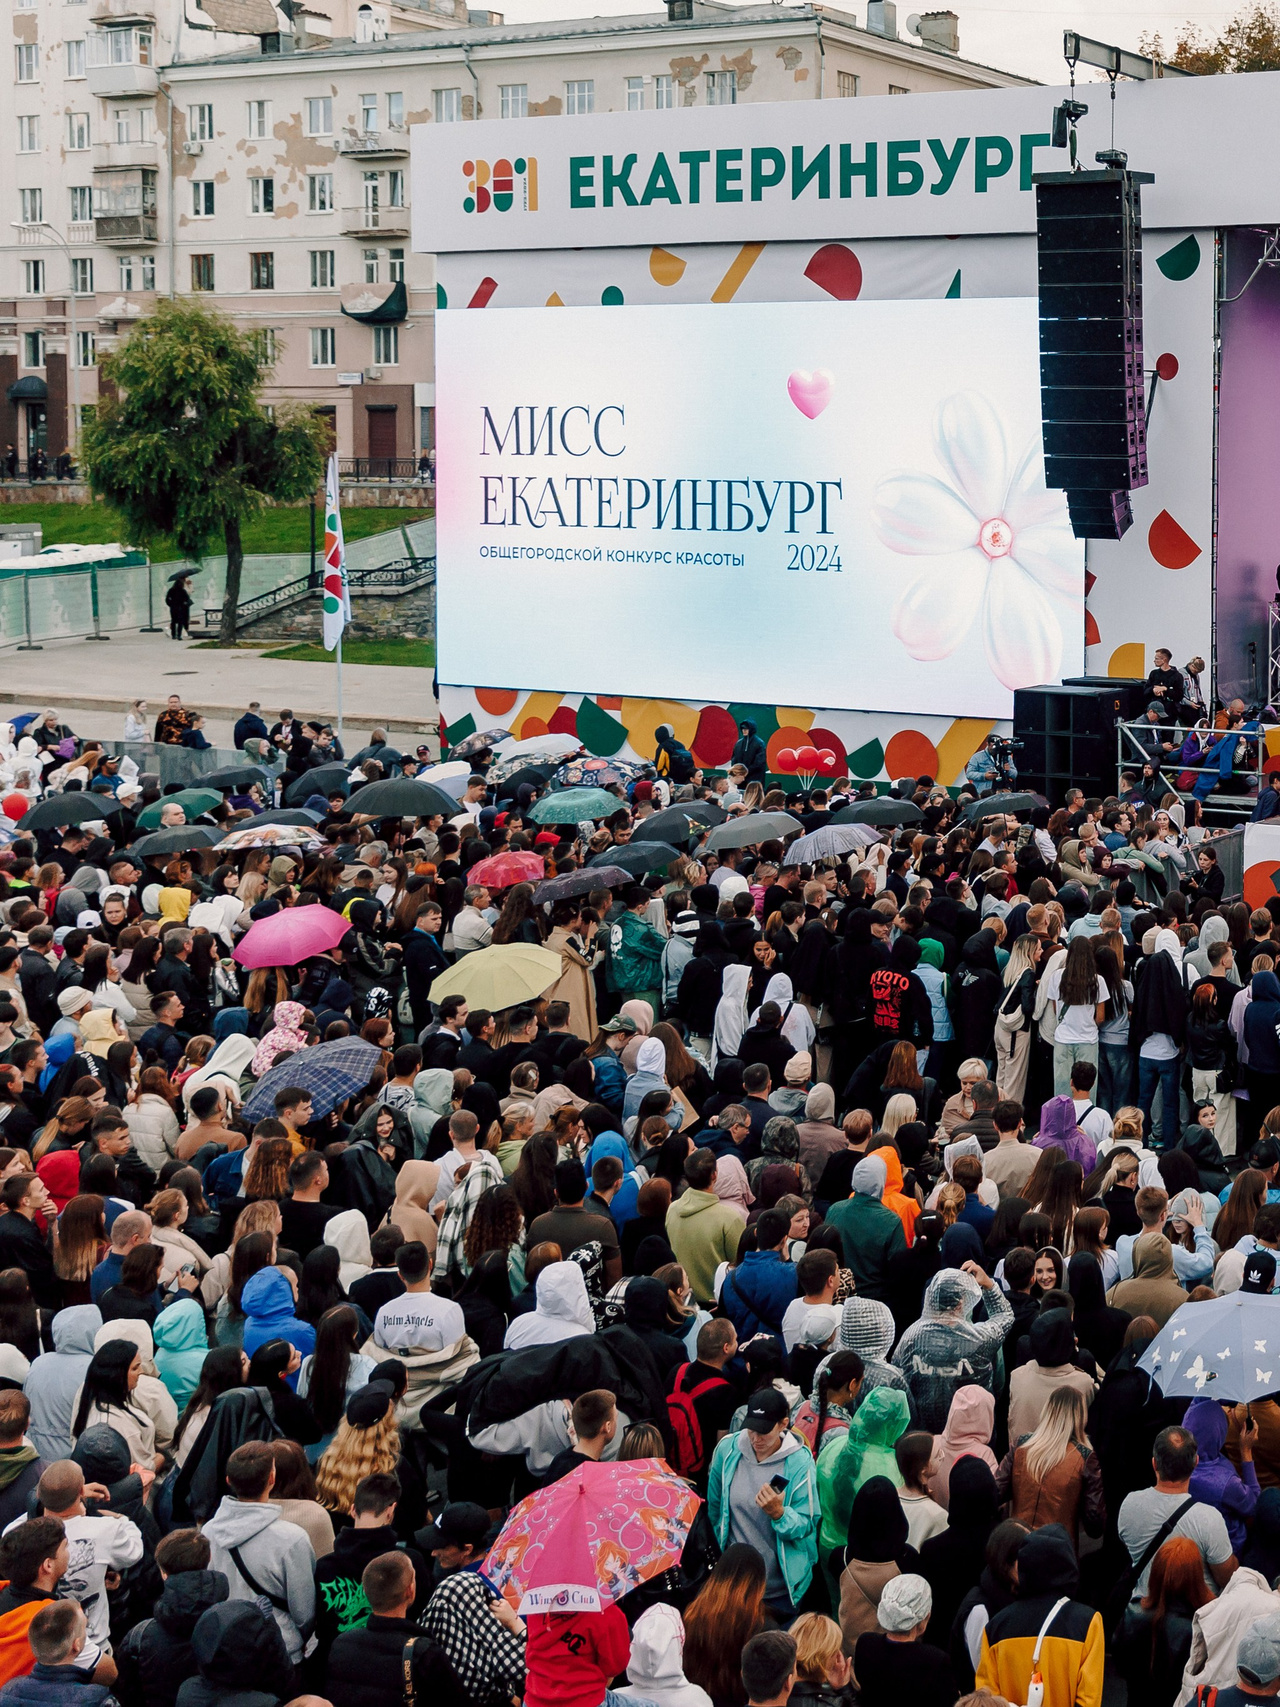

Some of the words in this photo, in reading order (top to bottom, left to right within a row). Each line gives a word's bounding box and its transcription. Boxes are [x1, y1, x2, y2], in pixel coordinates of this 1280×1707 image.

[570, 133, 1051, 209] ЕКАТЕРИНБУРГ
[479, 404, 627, 457] МИСС
[479, 473, 843, 534] ЕКАТЕРИНБУРГ
[479, 545, 602, 563] ОБЩЕГОРОДСКОЙ
[606, 549, 672, 564] КОНКУРС
[676, 552, 745, 567] КРАСОТЫ
[787, 543, 843, 572] 2024
[383, 1314, 404, 1329] Palm
[404, 1314, 434, 1328] Angels
[572, 1590, 594, 1604] Club
